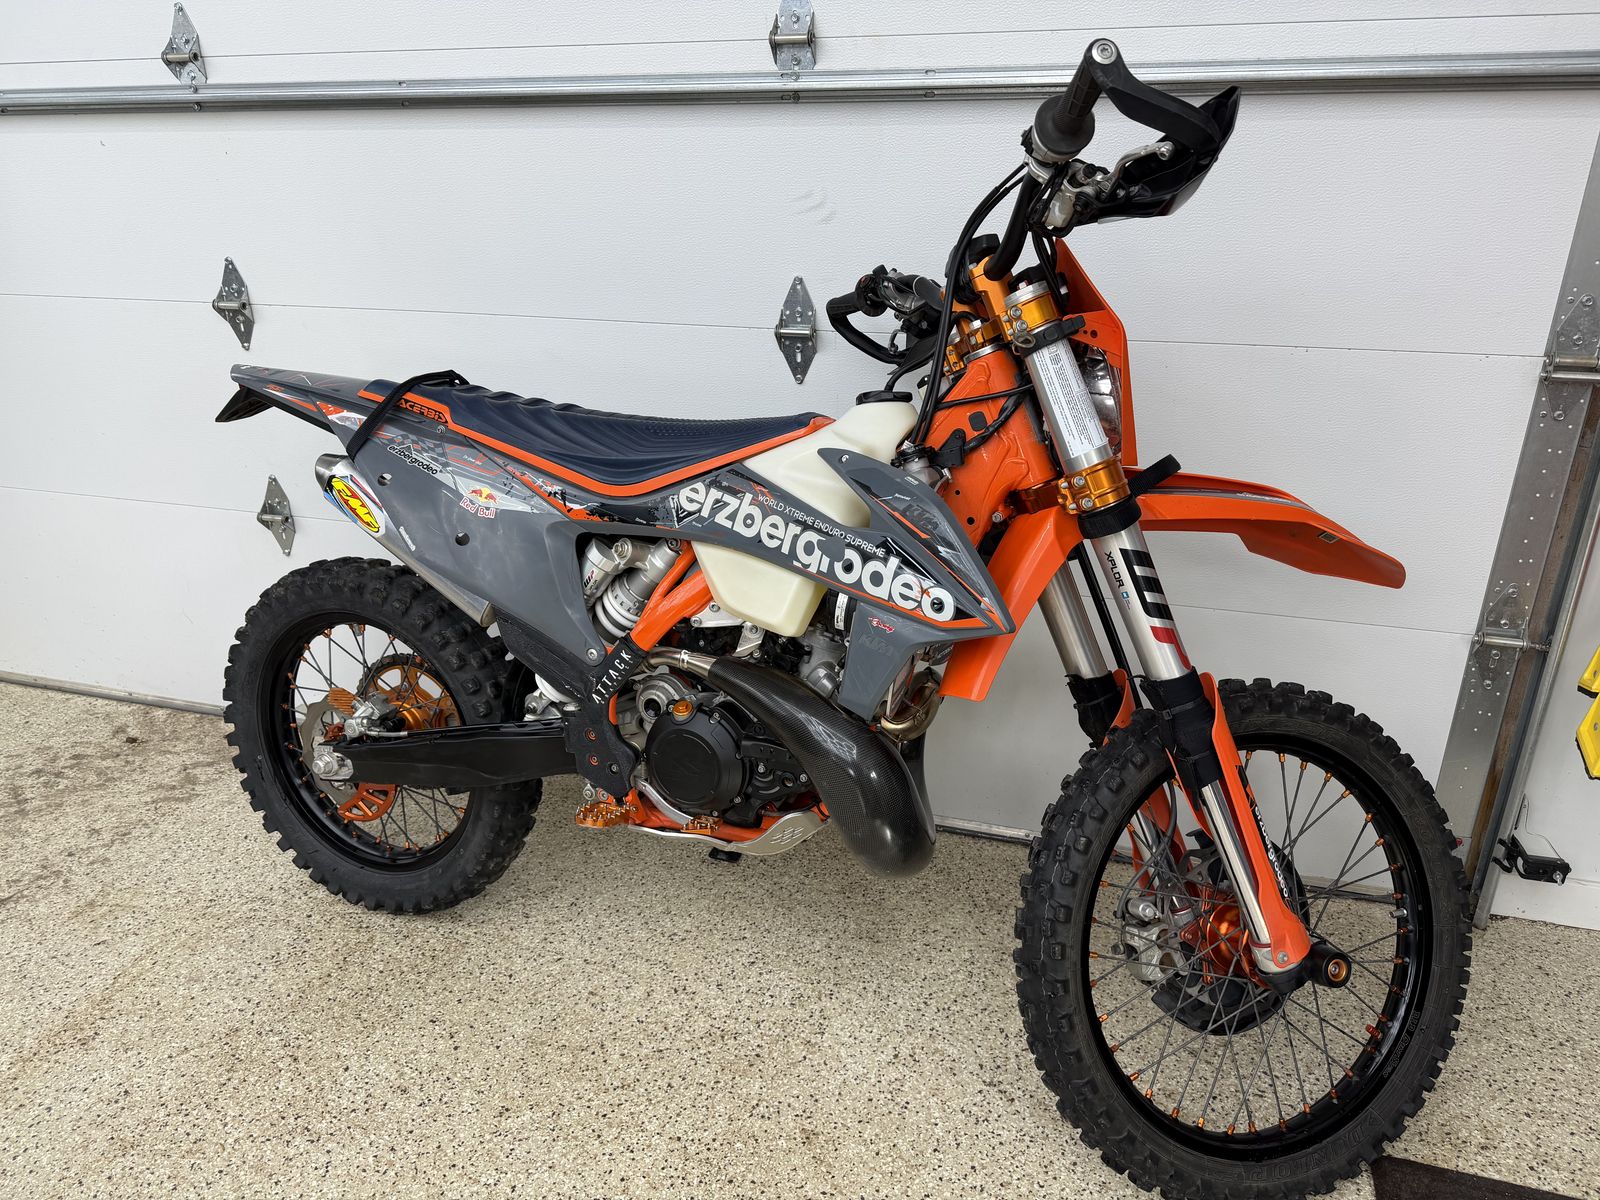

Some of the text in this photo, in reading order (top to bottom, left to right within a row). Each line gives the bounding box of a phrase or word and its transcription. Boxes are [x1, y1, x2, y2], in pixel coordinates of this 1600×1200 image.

[388, 444, 438, 475] erzbergrodeo
[331, 478, 381, 533] FMF
[461, 497, 496, 518] Red Bull
[757, 493, 886, 558] WORLD XTREME ENDURO SUPREME
[1104, 551, 1125, 588] XPLOR
[592, 650, 632, 704] ATTACK
